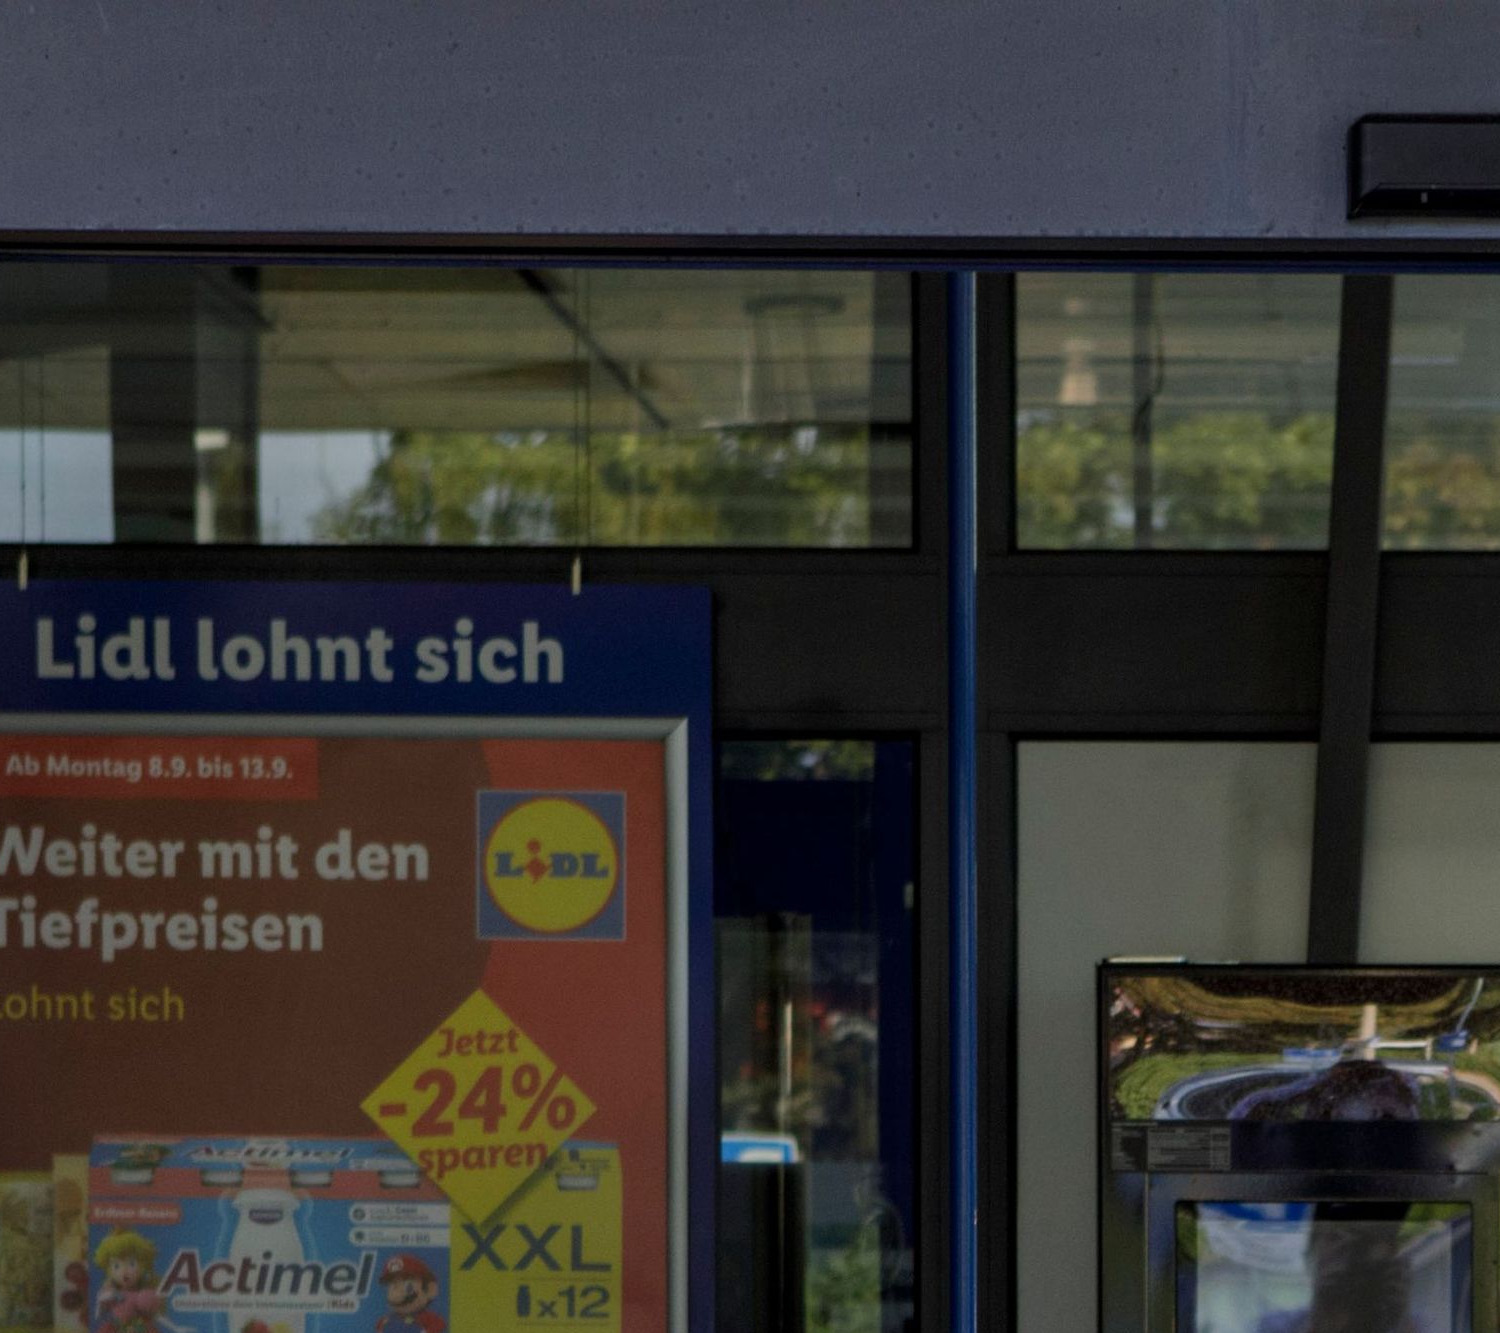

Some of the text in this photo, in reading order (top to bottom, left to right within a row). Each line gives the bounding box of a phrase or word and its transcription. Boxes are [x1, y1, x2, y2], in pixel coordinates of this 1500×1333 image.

[37, 614, 564, 683] Lidl lohnt sich
[6, 755, 294, 783] Ab Montag 8.9. bis 13.9.
[200, 826, 299, 879] mit
[315, 830, 429, 881] den
[108, 985, 185, 1022] sich
[438, 1028, 520, 1058] Jetzt
[378, 1063, 577, 1137] -24%
[418, 1139, 548, 1181] sparen
[460, 1224, 612, 1273] XXL
[160, 1252, 375, 1297] Actimel
